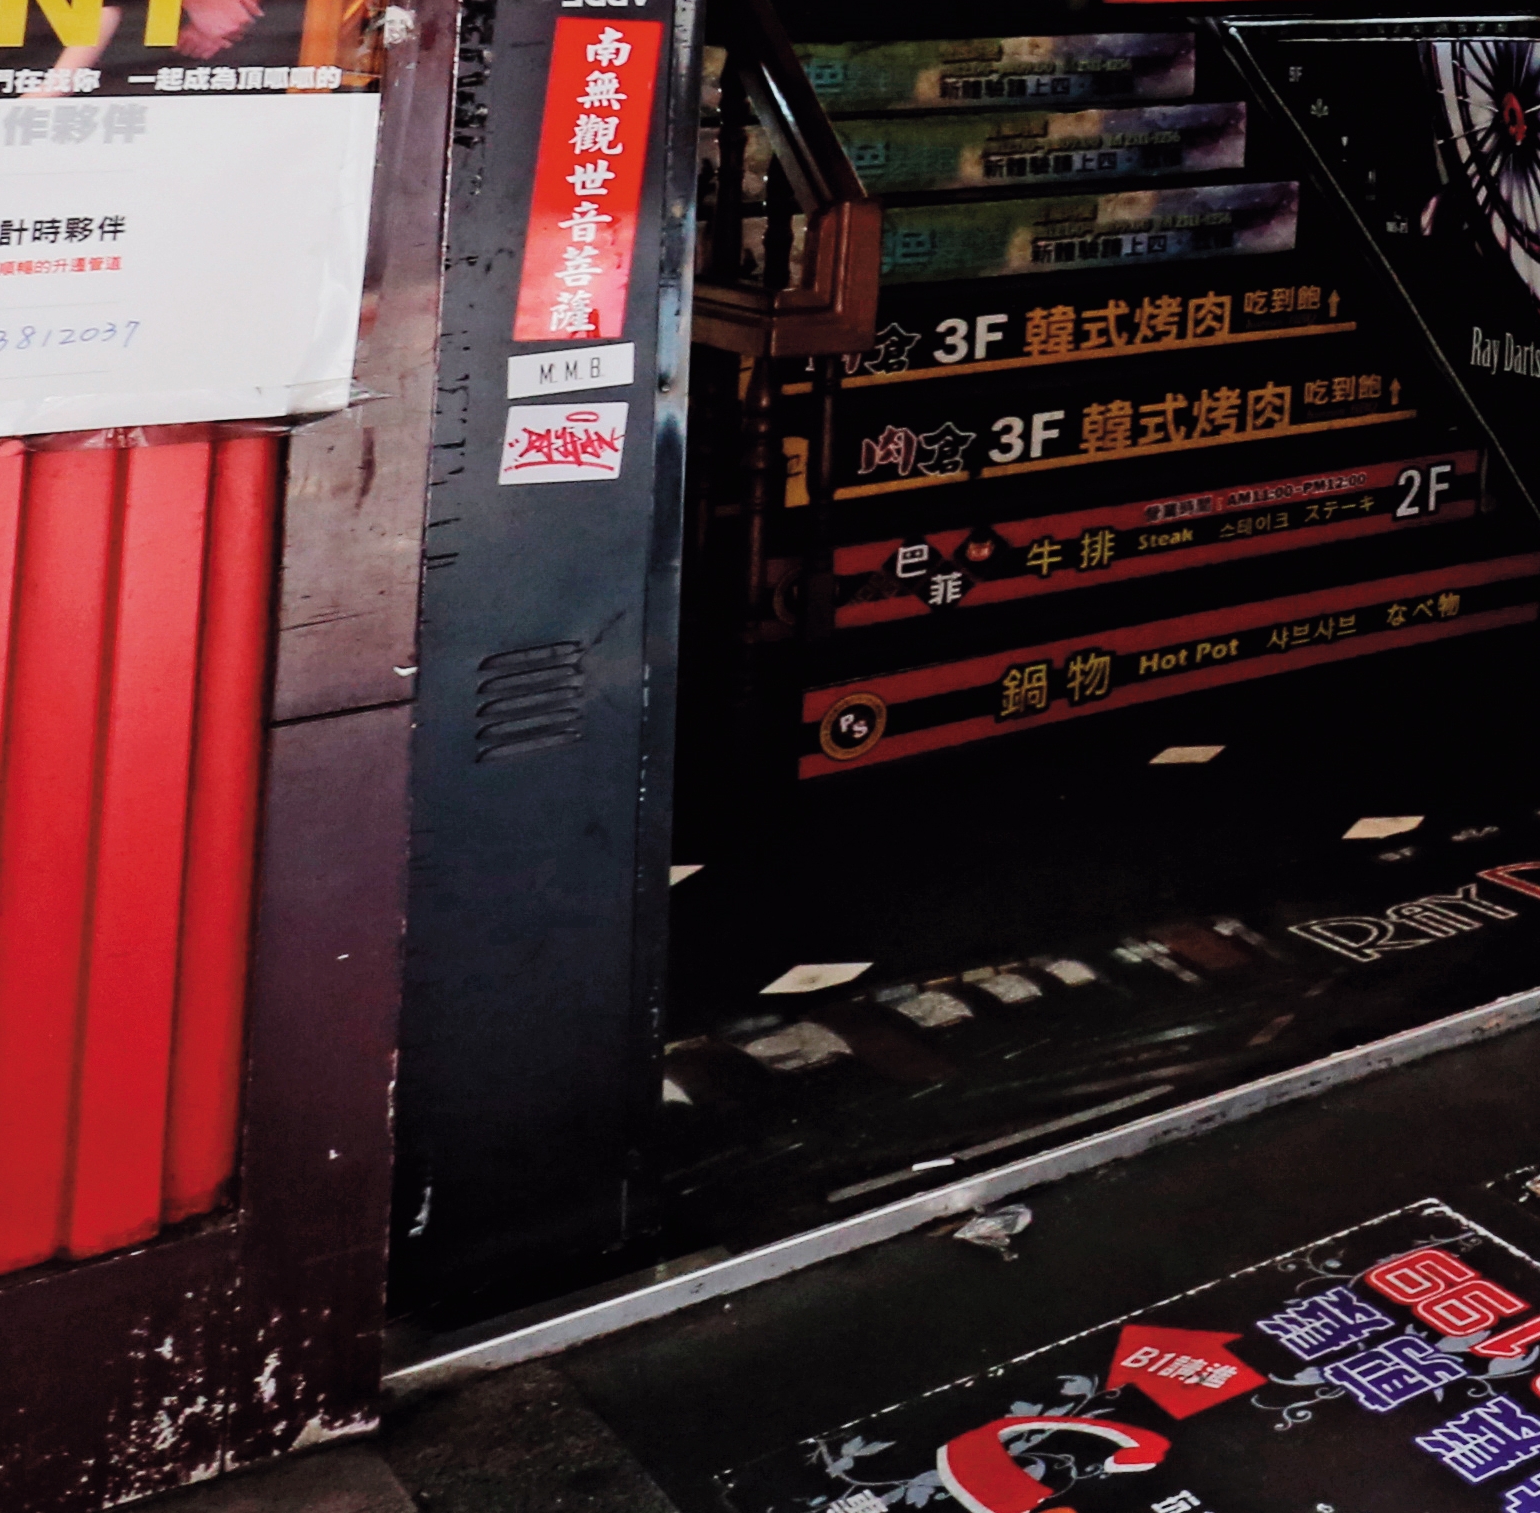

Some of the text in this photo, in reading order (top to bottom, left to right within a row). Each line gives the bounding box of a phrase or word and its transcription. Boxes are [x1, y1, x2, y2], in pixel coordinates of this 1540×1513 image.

[548, 26, 632, 333] 南無觀世音菩薩
[932, 285, 1322, 364] 3F 韓式烤肉 吃到飽
[1470, 326, 1501, 373] Ray
[988, 409, 1065, 464] 3F
[1077, 380, 1293, 456] 韓式烤肉
[1302, 374, 1383, 407] 吃到飽
[895, 543, 929, 579] 巴
[1025, 530, 1116, 576] 牛排
[1137, 525, 1195, 549] Steak
[1394, 463, 1453, 519] 2F
[1001, 651, 1112, 719] 鍋物
[1137, 649, 1189, 677] Hot
[1193, 636, 1240, 663] Pot
